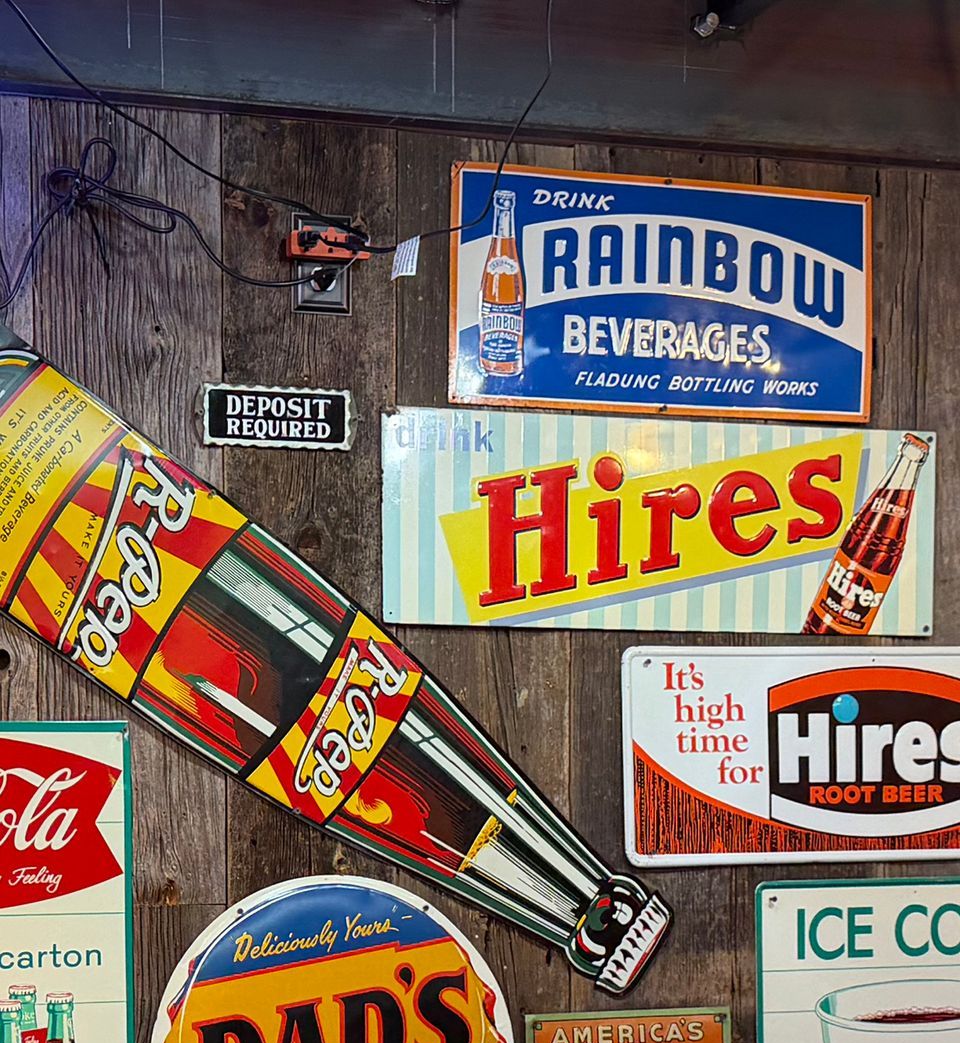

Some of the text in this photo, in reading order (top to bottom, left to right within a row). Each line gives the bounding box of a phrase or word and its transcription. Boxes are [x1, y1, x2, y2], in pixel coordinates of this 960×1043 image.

[532, 188, 615, 211] DRINK
[542, 223, 845, 329] RAINBOW
[562, 313, 773, 365] BEVERAGES
[52, 387, 69, 405] ACID
[575, 371, 819, 396] FLADUNG BOTTLING WORKS
[37, 404, 53, 421] AND
[60, 394, 79, 412] FROM
[226, 395, 332, 418] DEPOSIT
[8, 408, 27, 429] IT'S
[41, 412, 62, 433] OTHER
[54, 400, 88, 436] CONTAINS
[226, 418, 331, 440] REQUIRED
[21, 432, 43, 459] FRUITS
[395, 414, 494, 452] drink
[31, 435, 56, 463] PRUNE
[0, 430, 82, 542] A Carbonated Beverage
[13, 462, 33, 488] JUICE
[871, 497, 909, 517] Hires
[478, 454, 845, 607] Hires
[54, 511, 98, 619] MAKE IT YOURS
[827, 561, 883, 607] Hires
[663, 661, 705, 691] It's
[674, 694, 746, 730] high
[676, 727, 749, 754] time
[717, 755, 764, 785] for
[809, 784, 944, 805] ROOT BEER
[9, 866, 62, 893] Feeling
[797, 906, 875, 960] ICE
[0, 944, 102, 970] carton
